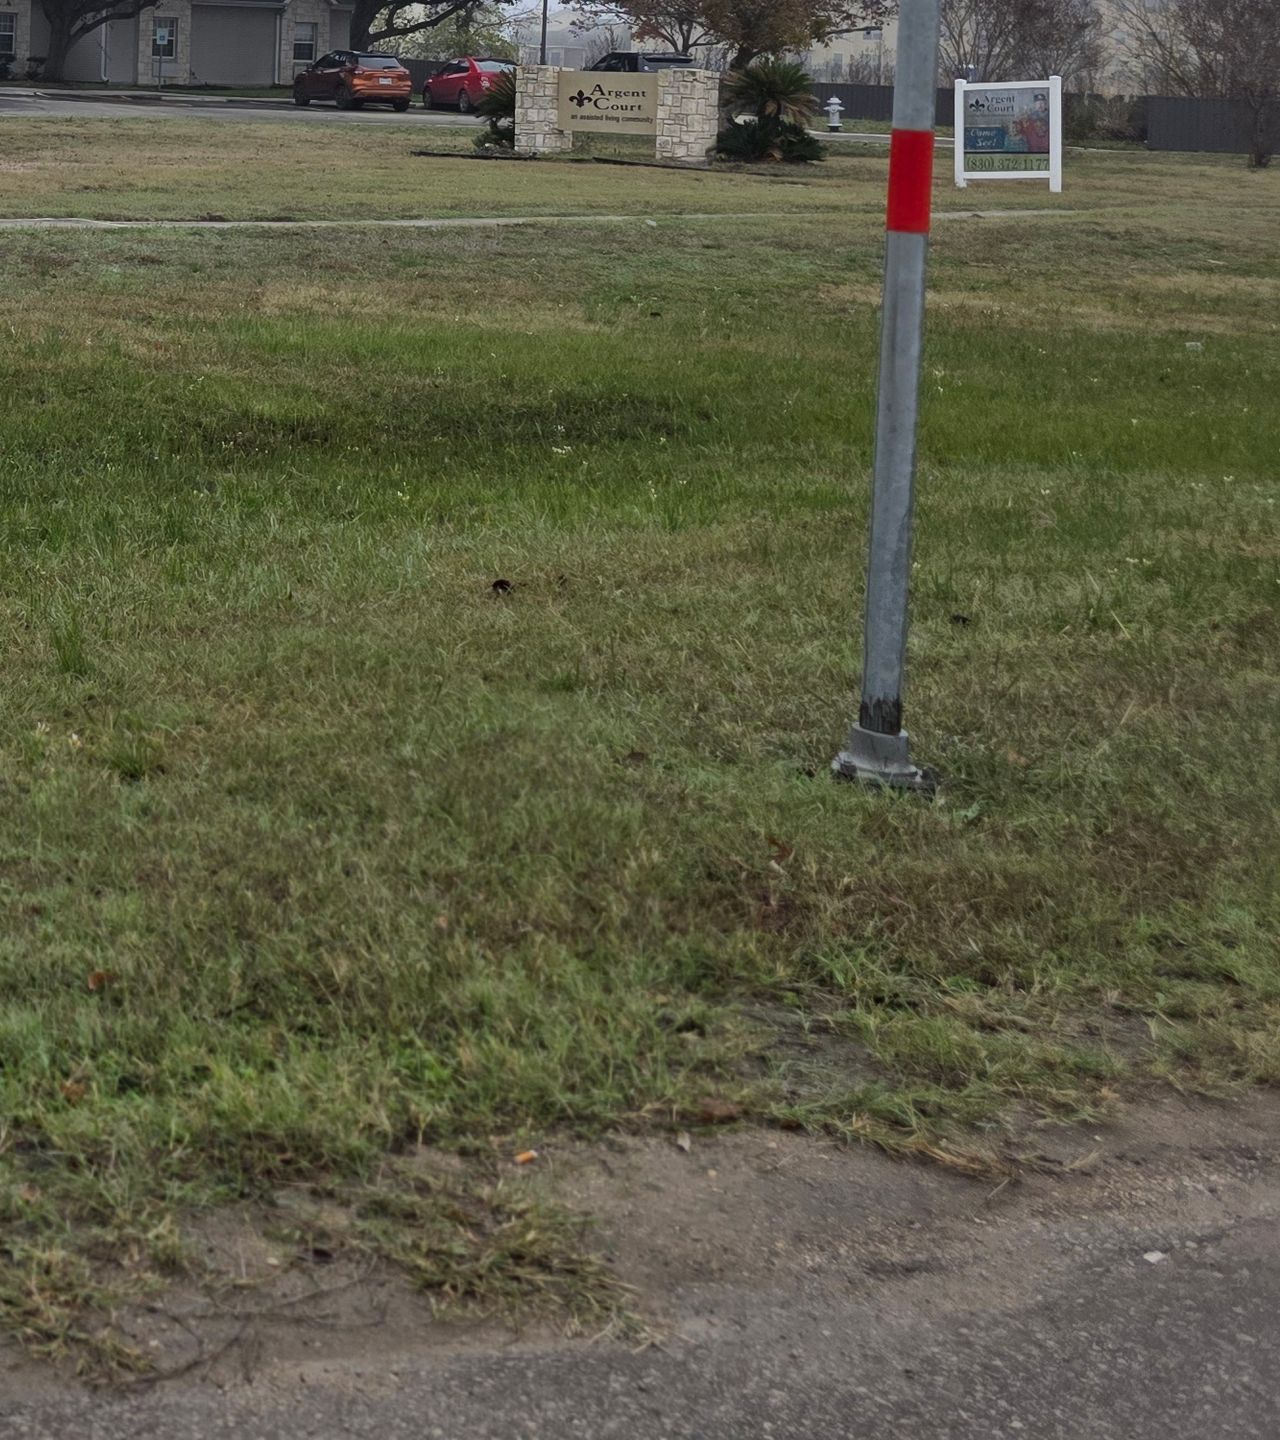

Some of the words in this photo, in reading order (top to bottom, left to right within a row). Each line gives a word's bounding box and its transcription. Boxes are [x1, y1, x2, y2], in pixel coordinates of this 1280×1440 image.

[590, 84, 647, 99] Argent
[593, 97, 642, 111] Court
[984, 95, 1015, 103] Argent
[987, 104, 1014, 112] Court
[967, 156, 995, 170] (830)
